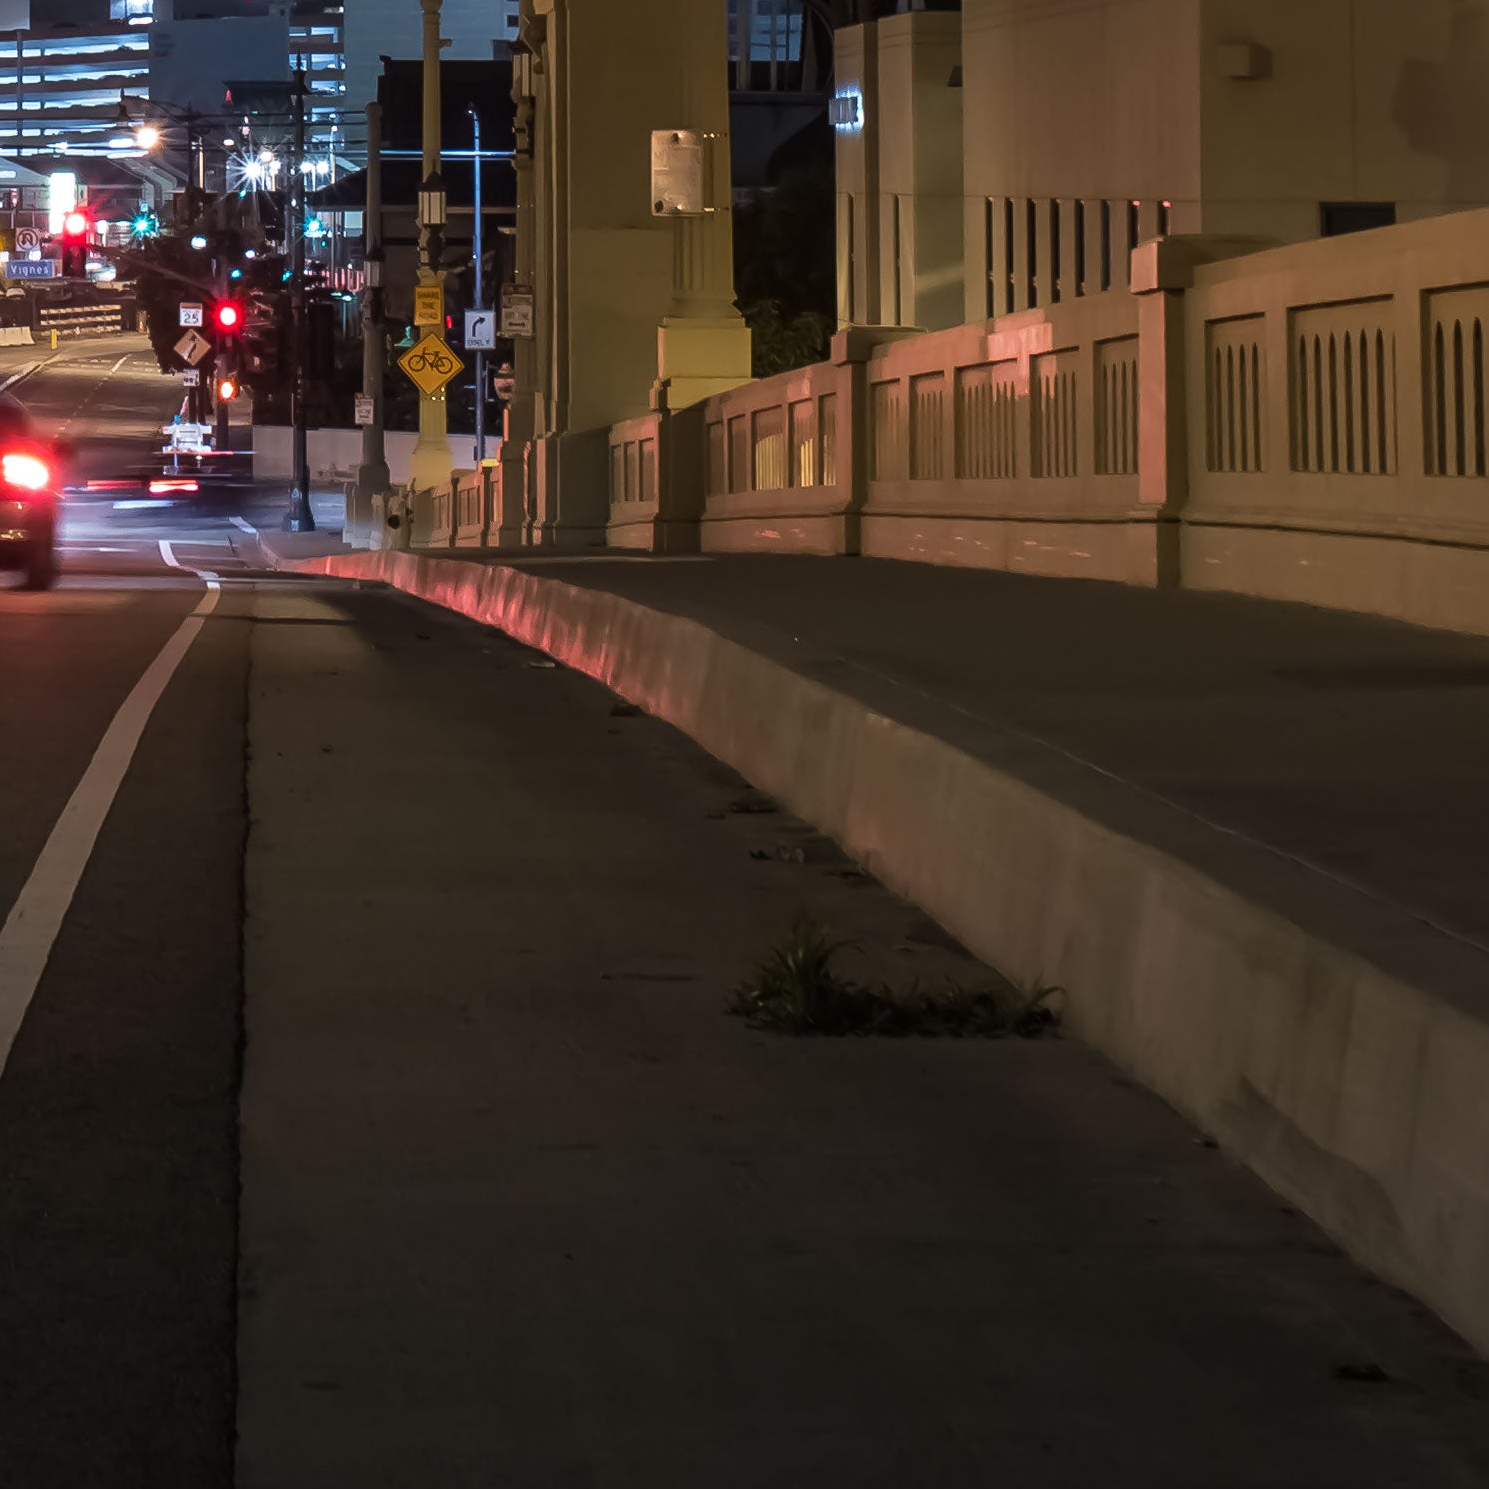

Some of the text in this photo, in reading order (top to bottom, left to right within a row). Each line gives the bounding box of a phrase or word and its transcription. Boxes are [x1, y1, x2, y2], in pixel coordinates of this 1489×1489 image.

[10, 265, 49, 277] Vignes
[184, 312, 199, 324] 25
[467, 339, 491, 347] ONLY
